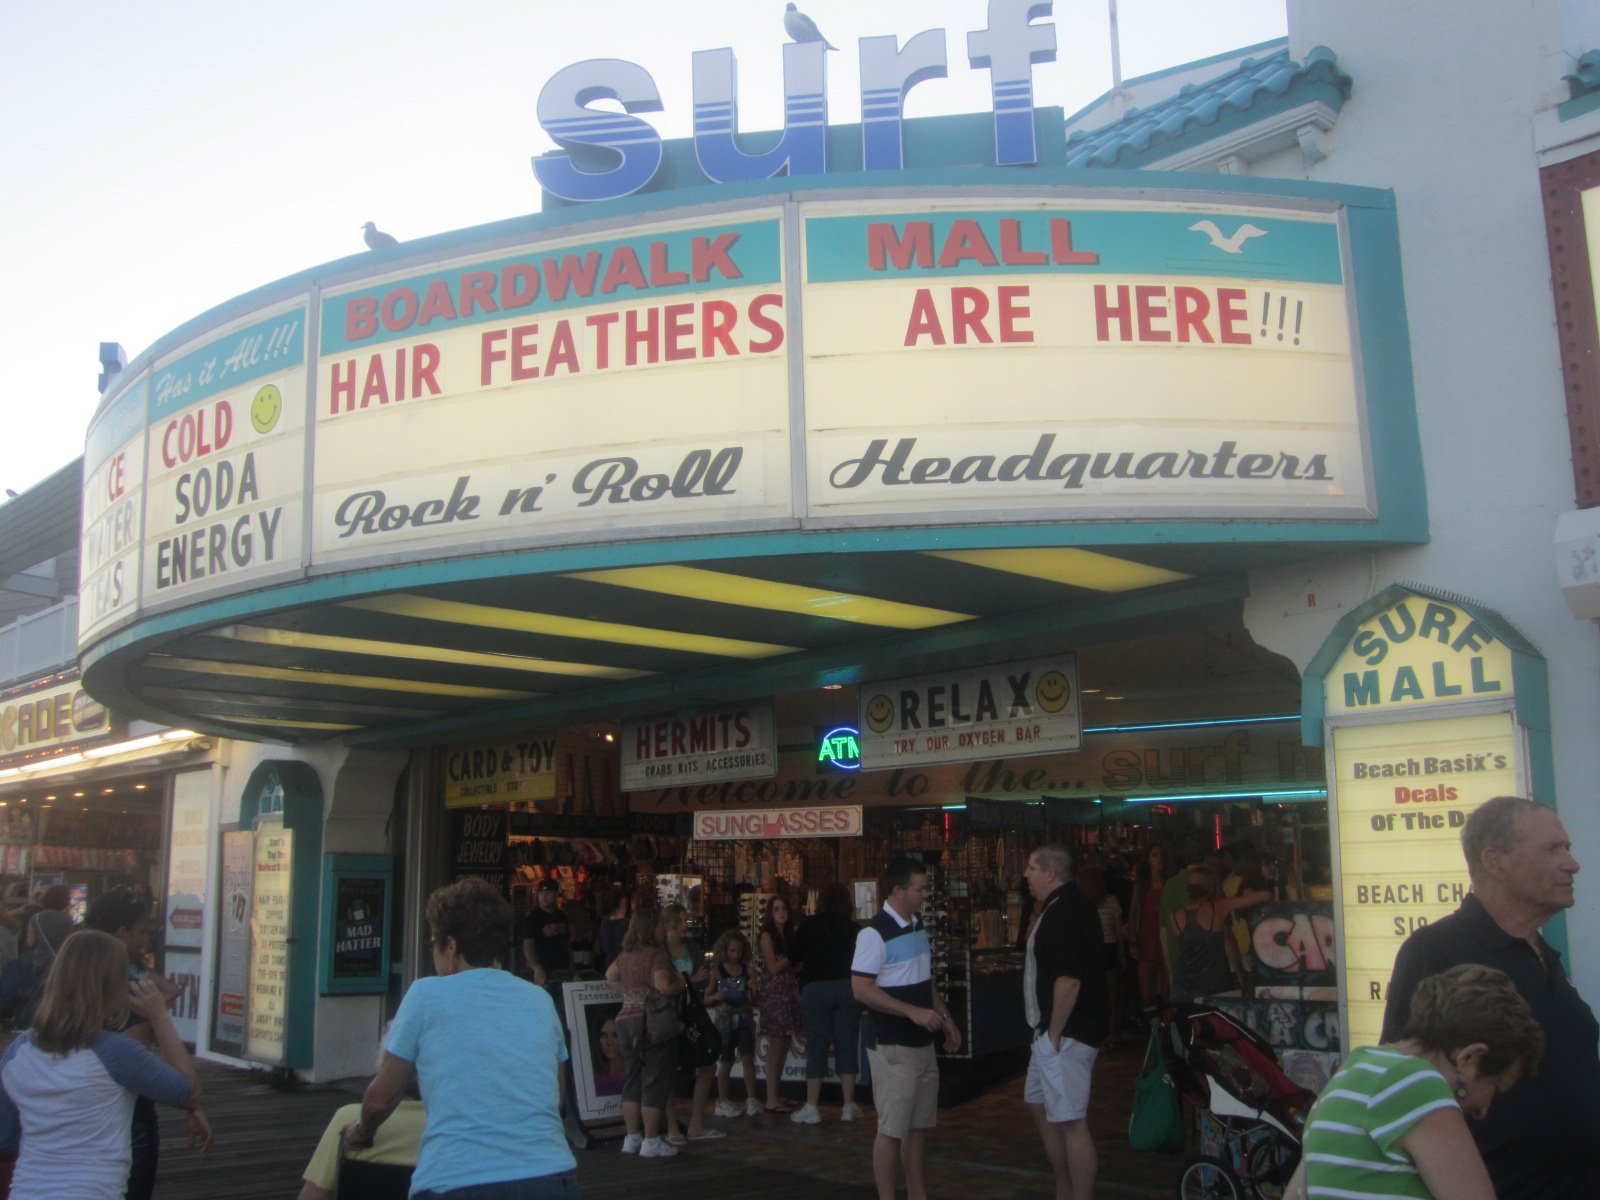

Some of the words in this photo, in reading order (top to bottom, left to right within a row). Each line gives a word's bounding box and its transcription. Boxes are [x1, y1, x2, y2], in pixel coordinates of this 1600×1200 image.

[531, 0, 1057, 201] surf
[345, 232, 743, 341] BOARDWALK
[867, 217, 1099, 271] MALL
[330, 343, 442, 415] HAIR
[480, 293, 784, 386] FEATHERS
[903, 285, 1034, 346] ARE
[154, 372, 191, 407] Has
[199, 356, 217, 386] it
[162, 400, 233, 469] COLD
[175, 452, 258, 525] SODA
[334, 476, 480, 538] Rock
[571, 446, 743, 508] Roll
[829, 433, 1333, 489] Headquarters
[156, 506, 282, 590] ENERGY
[1353, 602, 1494, 667] SURF
[900, 671, 1033, 731] RELAX
[1343, 656, 1502, 708] MALL
[636, 711, 752, 761] HERMITS
[894, 739, 916, 754] TRY
[926, 736, 950, 751] OUR
[958, 729, 1006, 748] OXYGEN
[1016, 725, 1041, 742] BAR
[449, 748, 497, 782] CARD
[516, 739, 557, 774] TOY
[706, 752, 767, 772] ACCESSORIES
[1353, 758, 1420, 780] Beach
[1394, 784, 1458, 804] Deals
[463, 814, 500, 838] BODY
[700, 810, 850, 836] SUNGLASSES
[1371, 813, 1397, 832] Of
[1400, 811, 1444, 831] The
[456, 840, 502, 864] JEWELRY
[1357, 883, 1424, 904] BEACH
[1437, 882, 1473, 903] CH
[336, 936, 381, 953] HATTER
[346, 924, 373, 938] MAD
[578, 993, 623, 1001] Extensio
